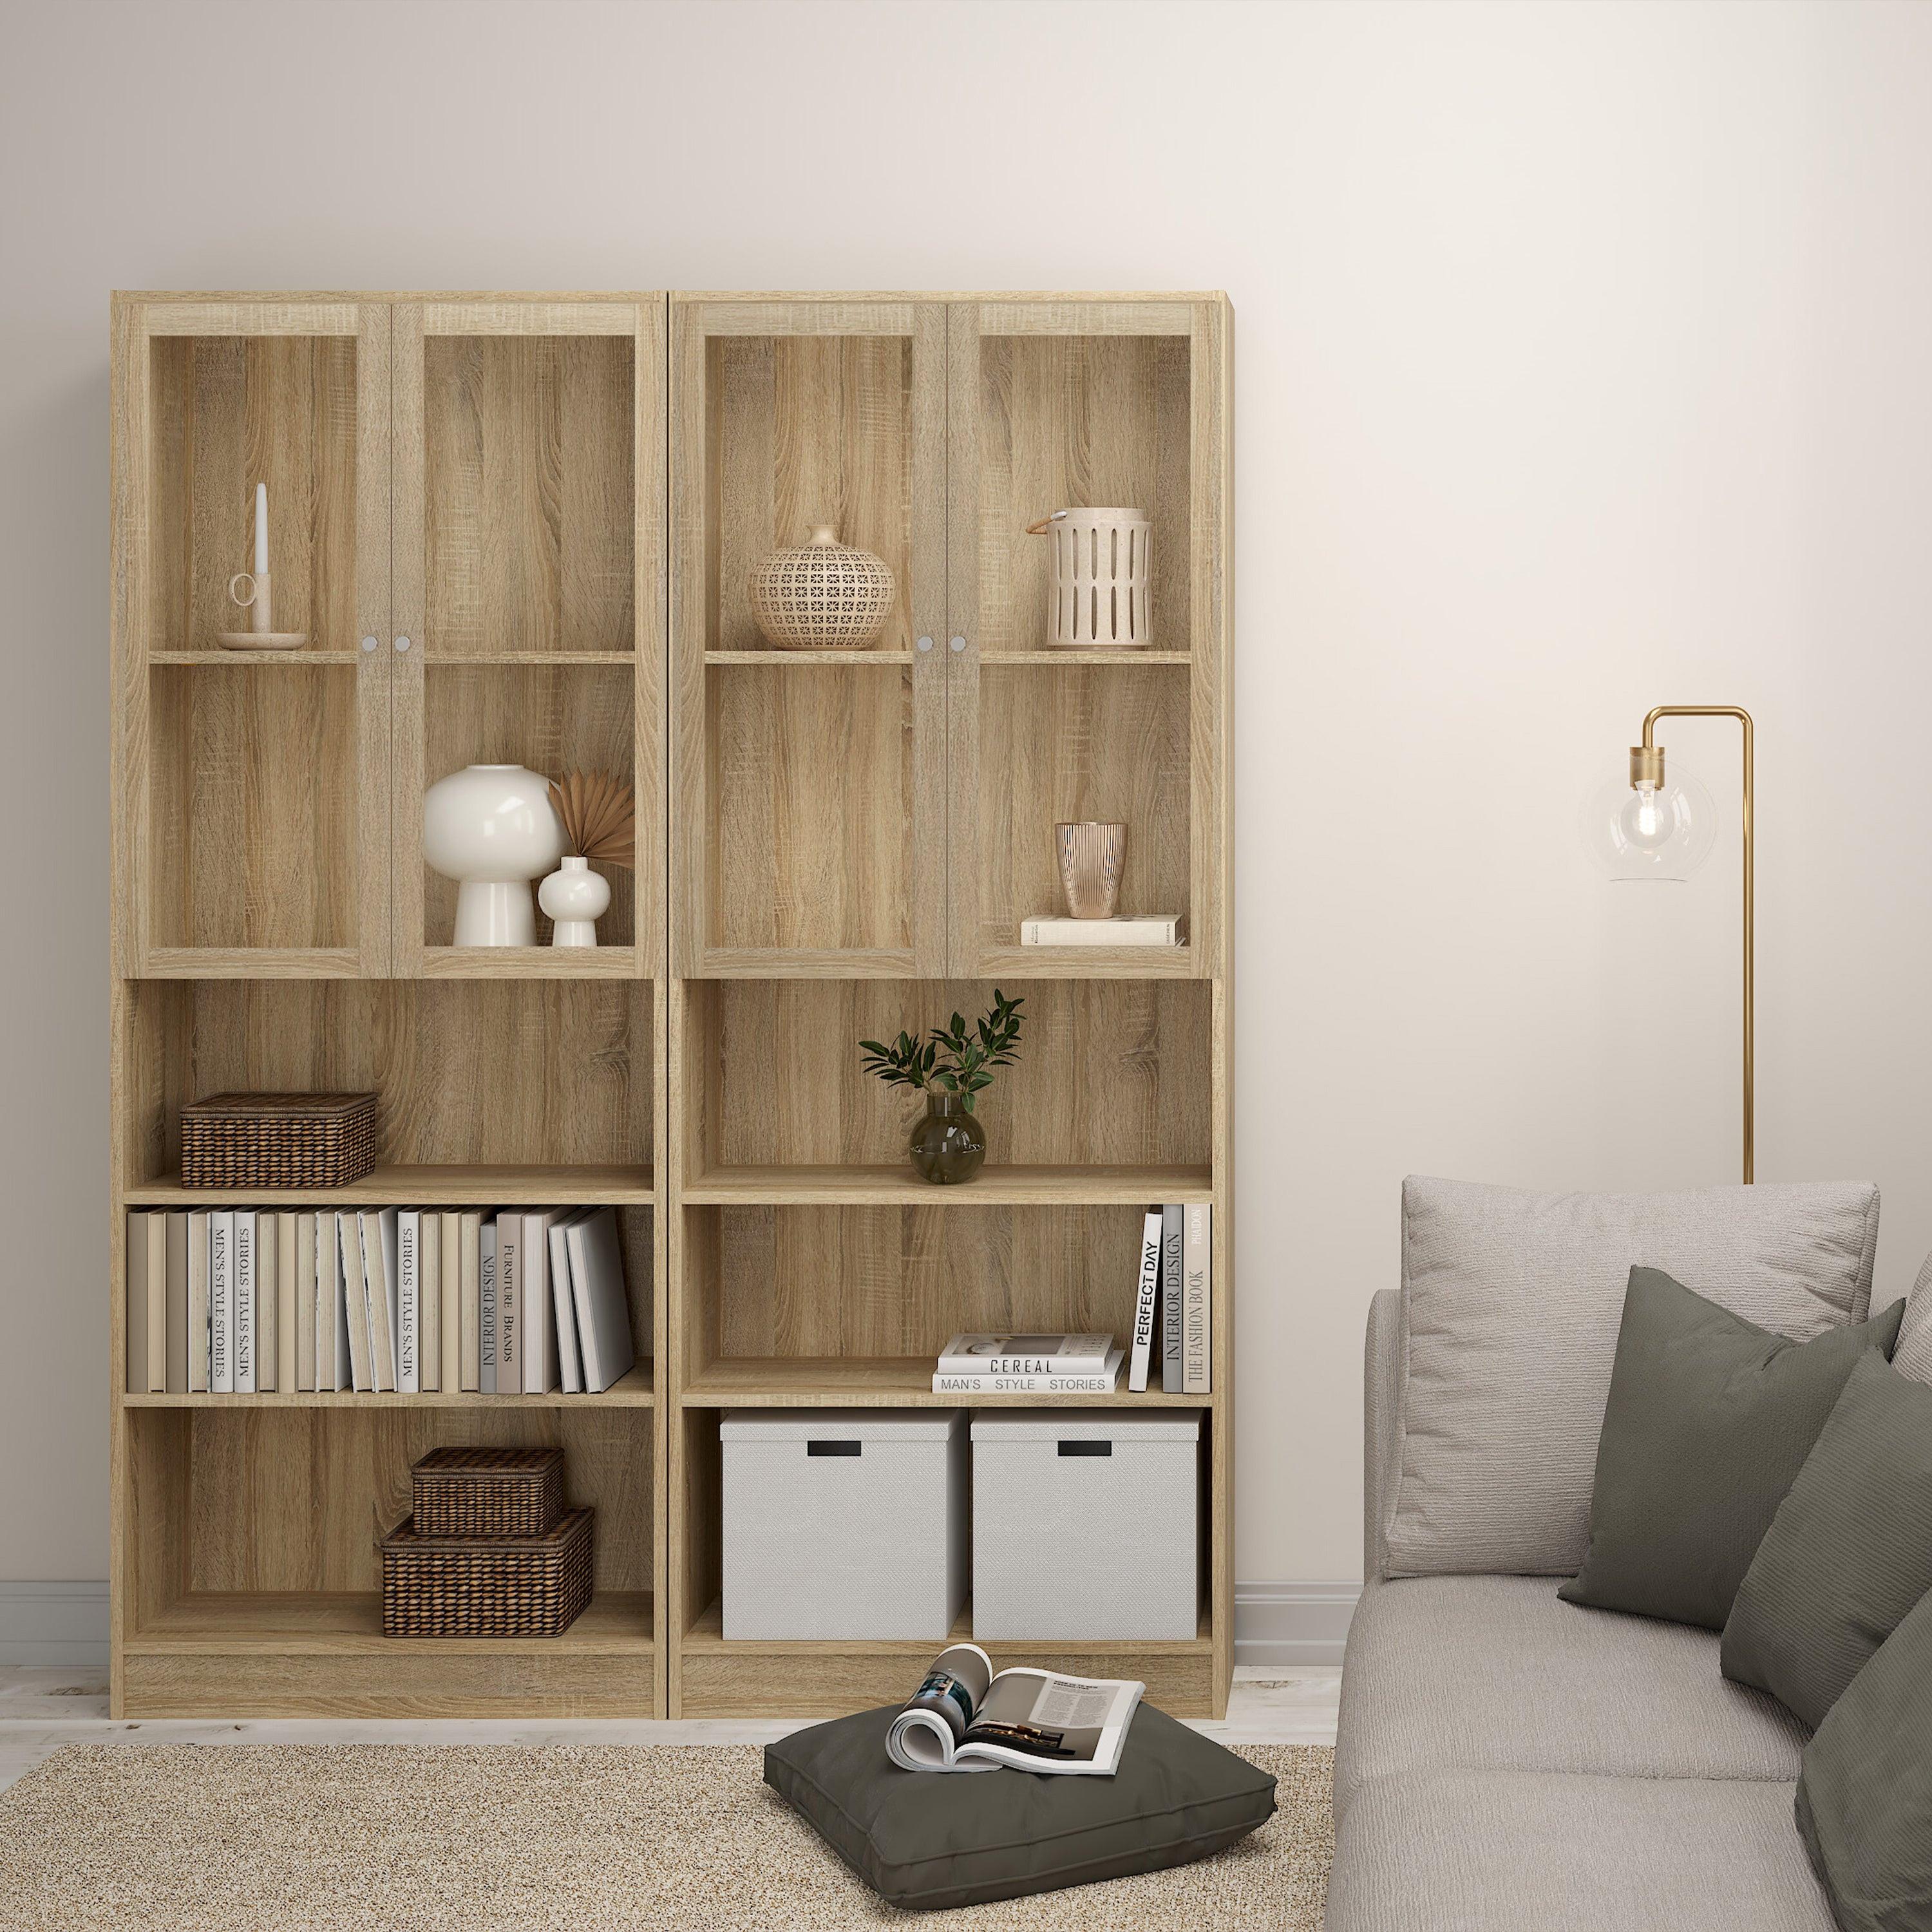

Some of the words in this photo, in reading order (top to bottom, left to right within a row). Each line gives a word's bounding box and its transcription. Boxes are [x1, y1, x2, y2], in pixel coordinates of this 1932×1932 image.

[216, 1229, 224, 1271] MEN'S
[240, 1227, 249, 1285] STORIES
[403, 1227, 412, 1285] STORIES
[1144, 1241, 1158, 1272] DAY
[1166, 1233, 1180, 1288] DESIGN
[216, 1274, 224, 1317] STYLE
[483, 1255, 495, 1302] DESIGN
[1188, 1271, 1204, 1304] BOOK
[240, 1289, 249, 1332] STYLE
[403, 1289, 412, 1332] STYLE
[1137, 1274, 1154, 1345] PERFECT
[1166, 1291, 1180, 1360] INTERIOR
[216, 1320, 224, 1378] STORIES
[483, 1305, 495, 1366] INTERIOR
[1188, 1307, 1204, 1356] FASHION
[240, 1335, 249, 1377] MEN'S
[403, 1335, 412, 1377] MEN'S
[990, 1359, 1052, 1373] CEREAL
[1188, 1356, 1203, 1383] THE
[941, 1379, 981, 1390] MAN'S
[995, 1379, 1036, 1390] STYLE
[1050, 1379, 1105, 1390] STORIES
